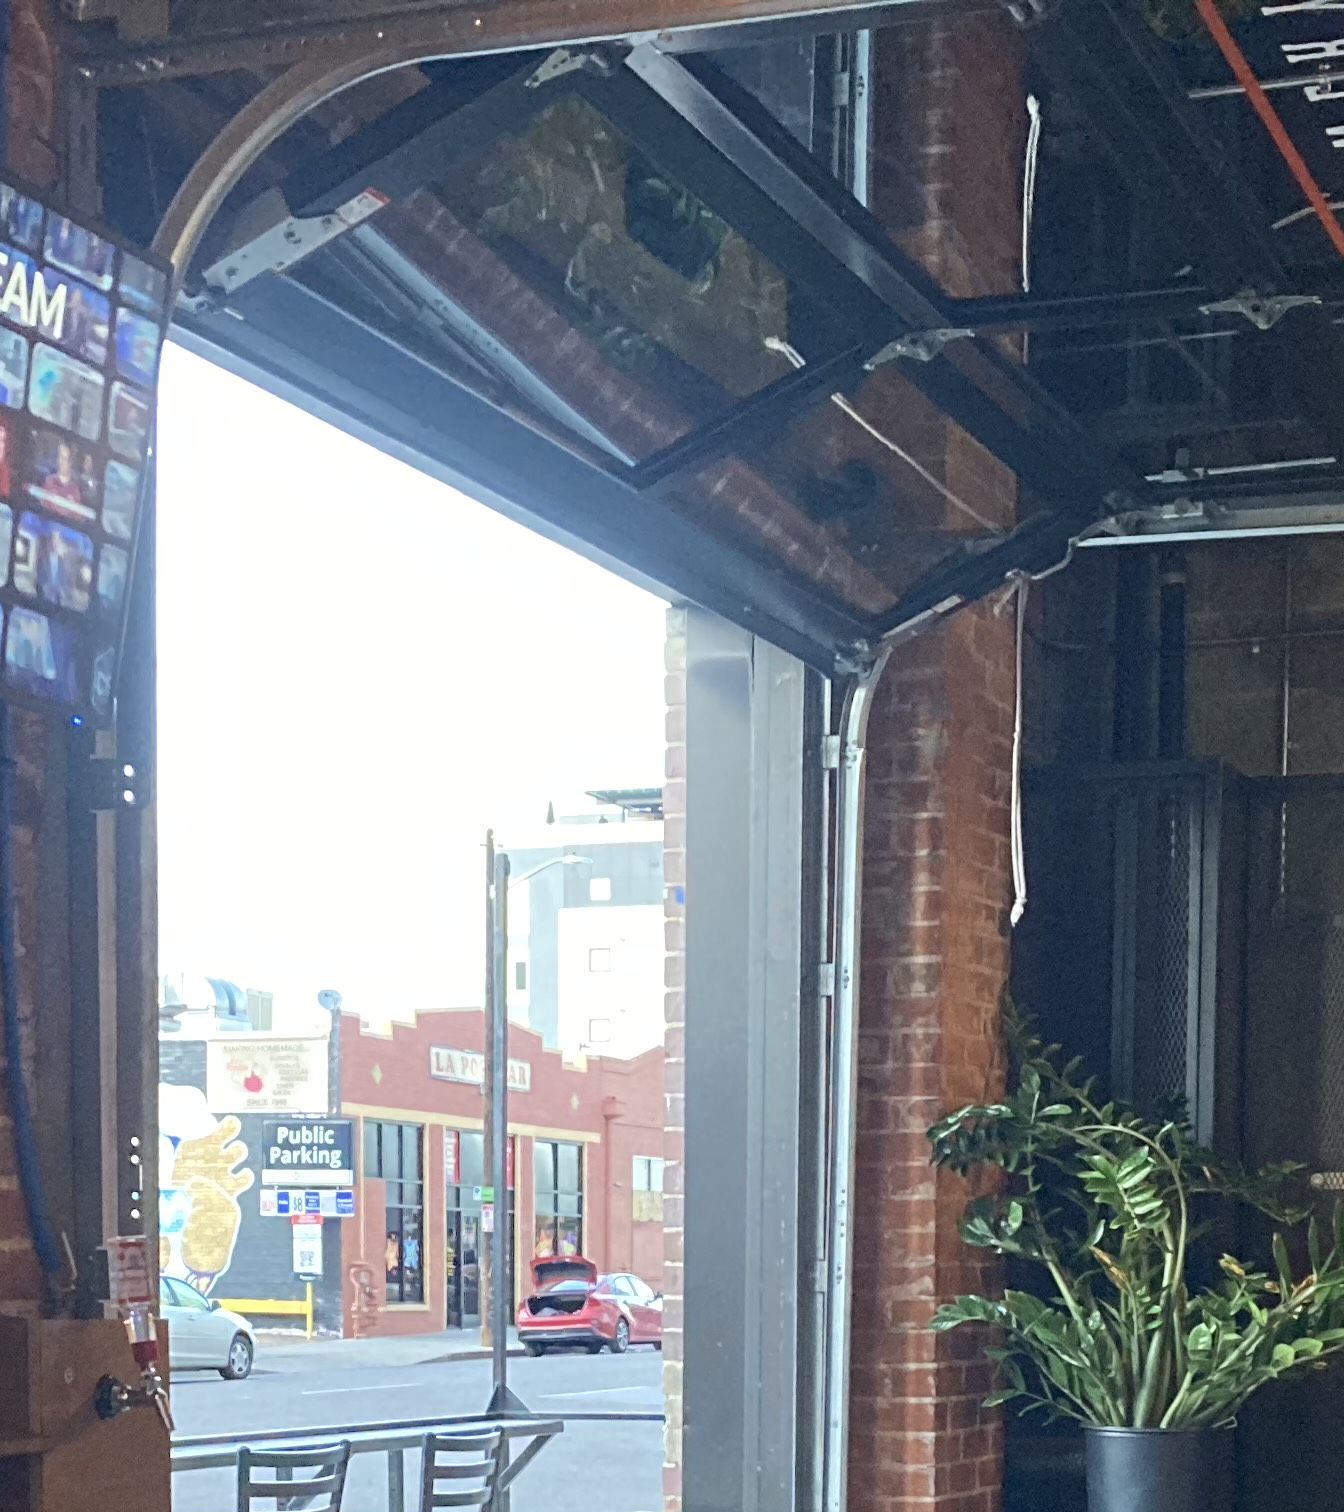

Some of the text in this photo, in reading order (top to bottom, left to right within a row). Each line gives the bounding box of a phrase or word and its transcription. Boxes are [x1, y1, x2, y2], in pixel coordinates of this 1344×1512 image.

[434, 1052, 526, 1085] LA POAR
[276, 1126, 335, 1144] Public
[269, 1146, 343, 1168] Parking
